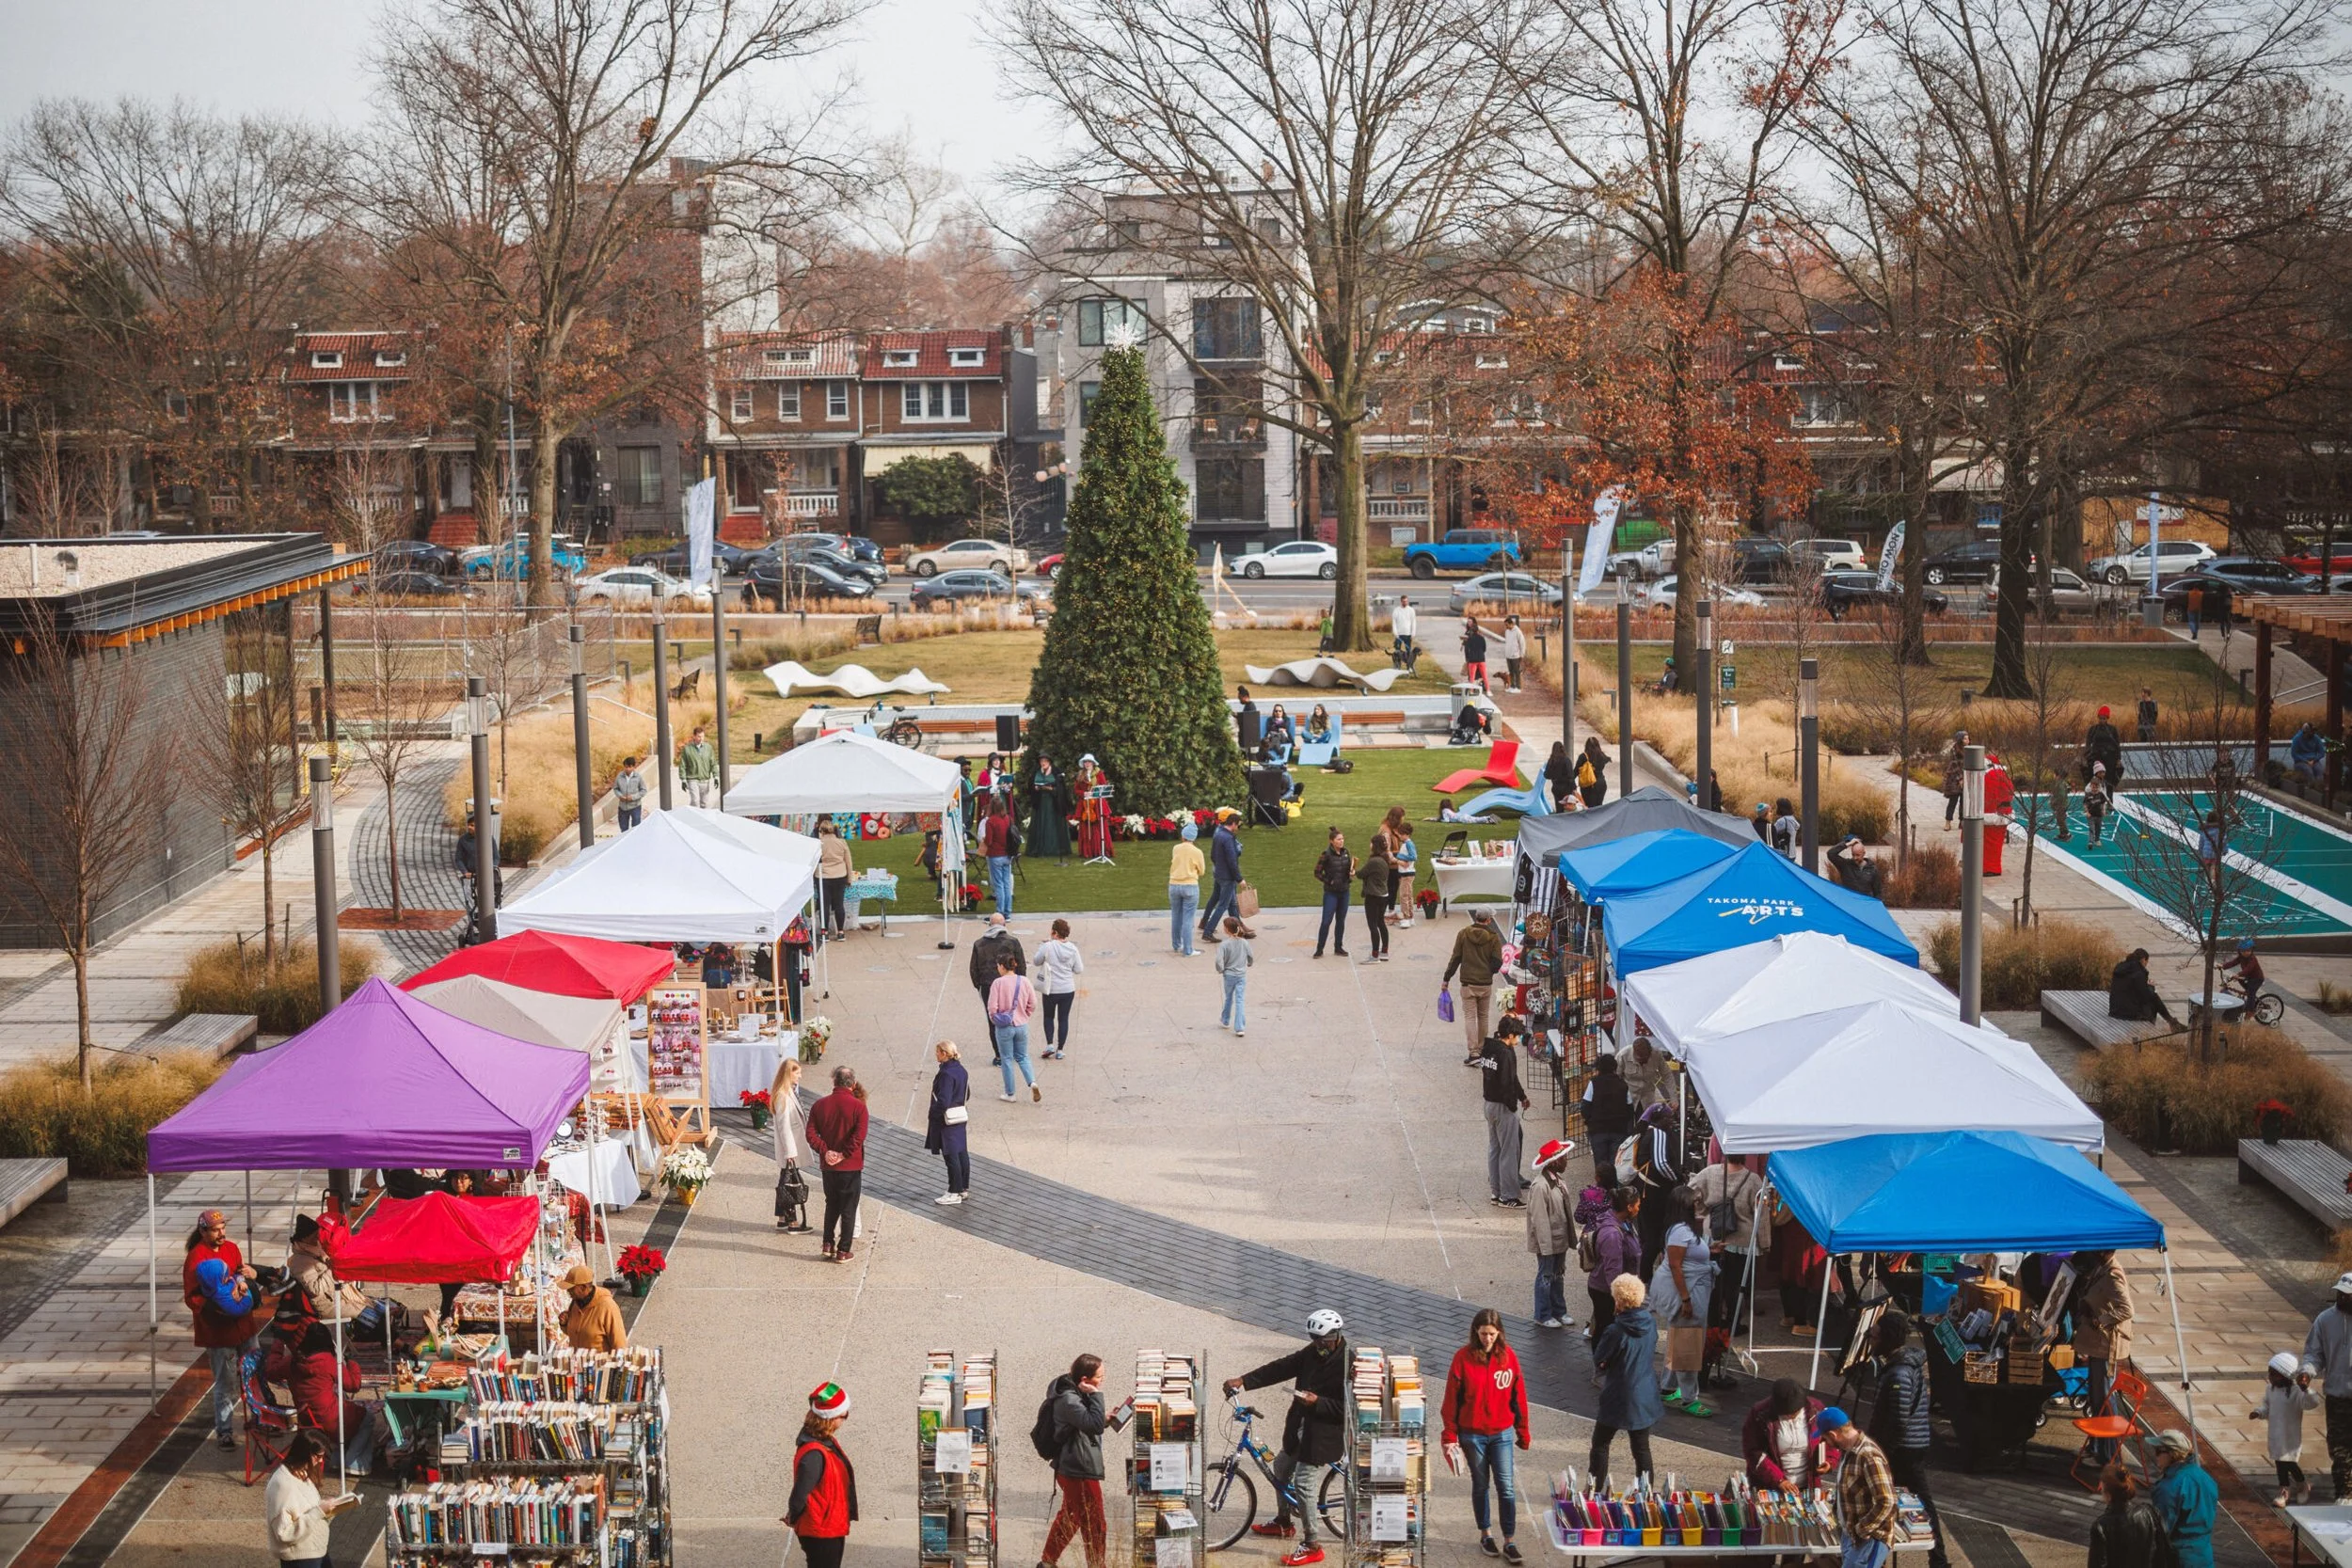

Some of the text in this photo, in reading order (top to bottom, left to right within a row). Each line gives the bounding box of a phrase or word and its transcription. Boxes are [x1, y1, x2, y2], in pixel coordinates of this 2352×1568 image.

[1884, 532, 1900, 559] NOW
[1741, 905, 1804, 916] ARTS
[1493, 1368, 1514, 1390] W
